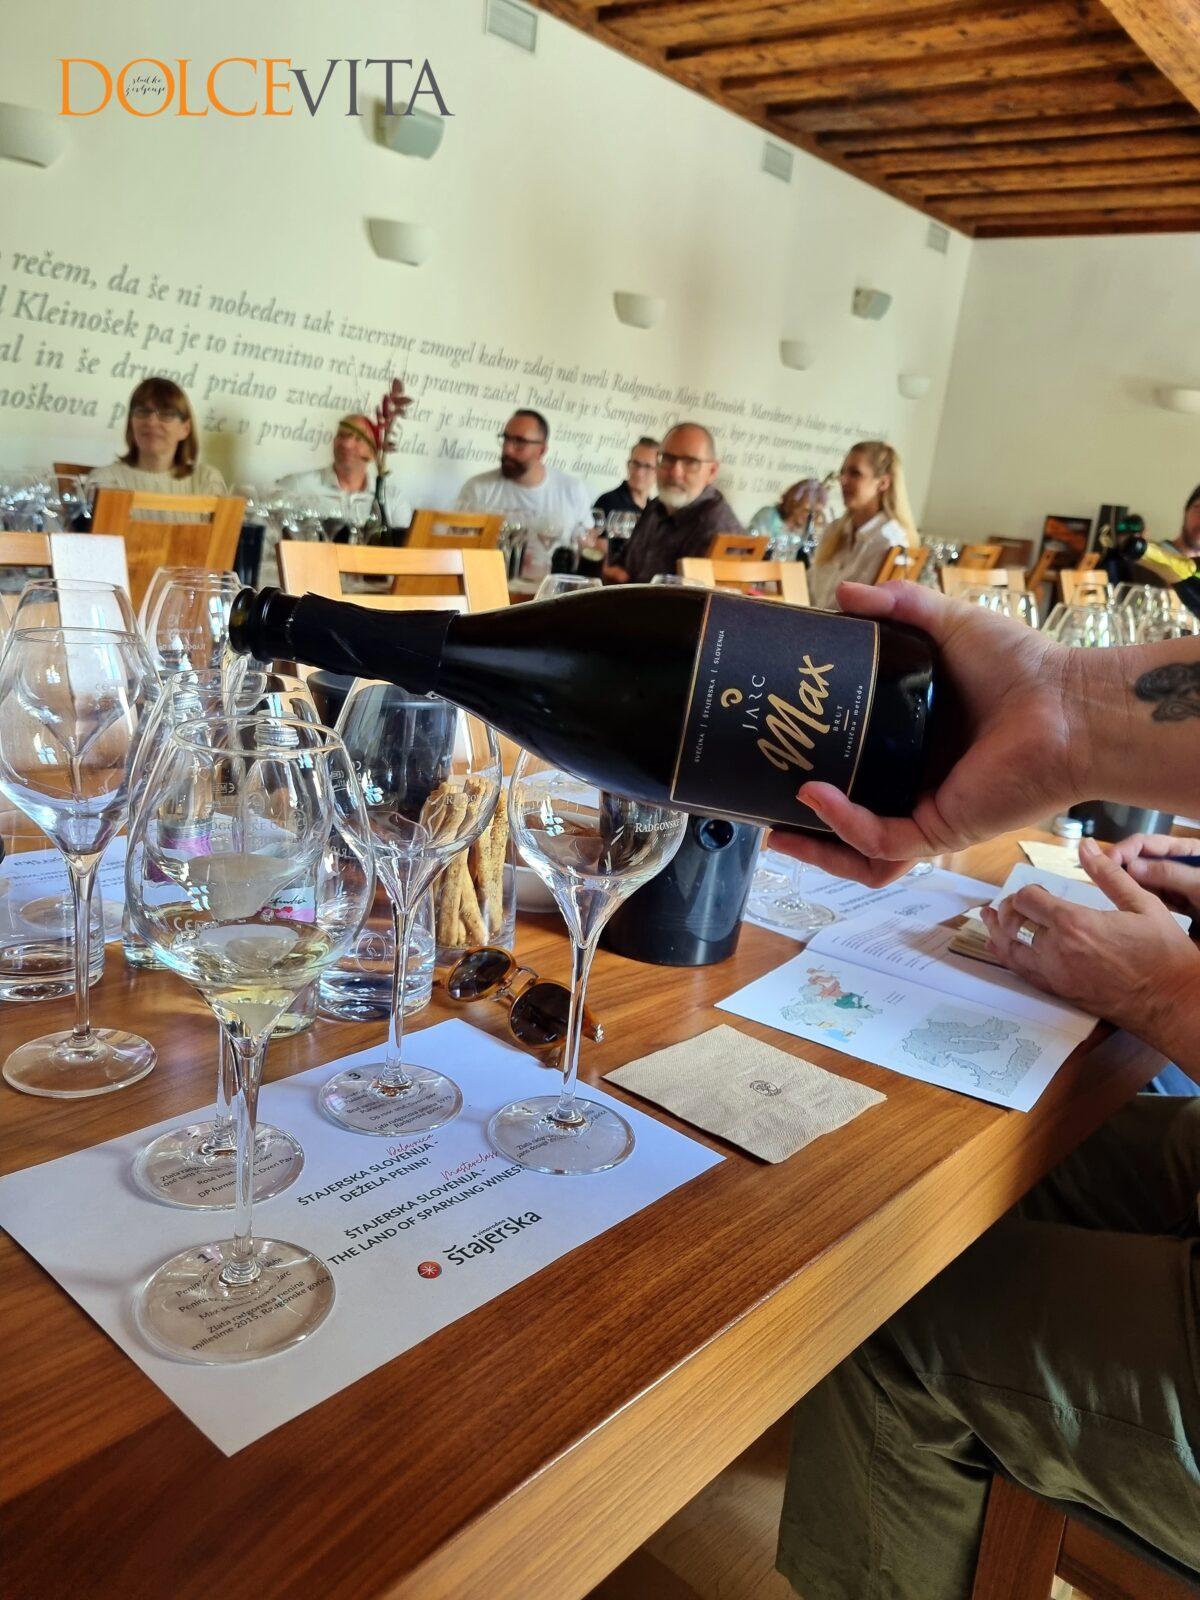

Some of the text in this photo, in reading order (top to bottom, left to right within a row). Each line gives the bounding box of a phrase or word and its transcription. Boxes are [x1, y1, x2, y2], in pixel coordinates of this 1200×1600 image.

[12, 250, 97, 290] rečem,
[107, 263, 140, 296] da
[147, 274, 170, 301] še
[176, 284, 203, 308] ni
[208, 290, 296, 328] nobeden
[302, 310, 334, 336] tak
[420, 341, 476, 369] zmogel
[13, 288, 139, 338] Kleinošek
[140, 322, 174, 351] pa
[174, 323, 201, 355] je
[205, 333, 227, 354] to
[231, 333, 325, 371] imenitno
[35, 341, 64, 370] in
[75, 347, 101, 375] še
[203, 371, 278, 402] pridno
[713, 630, 726, 665] SLOVENIJA
[741, 674, 767, 732] JARC
[756, 654, 835, 772] Max
[832, 704, 844, 732] BRUT
[348, 1072, 361, 1080] 3
[197, 1188, 211, 1200] DP
[297, 1168, 372, 1207] ŠTAJERSKA
[369, 1142, 435, 1174] SLOVENIJA
[339, 1157, 432, 1204] DEŽELA PENIN?
[327, 1164, 526, 1266] THE LAND OF SPARKLING WINES?
[343, 1199, 415, 1240] ŠTAJERSKA
[416, 1169, 481, 1204] SLOVENIJA
[196, 1251, 214, 1264] 1
[206, 1319, 232, 1335] Zlata
[231, 1294, 278, 1324] radgonska
[275, 1279, 306, 1303] penina
[191, 1324, 236, 1352] millesime
